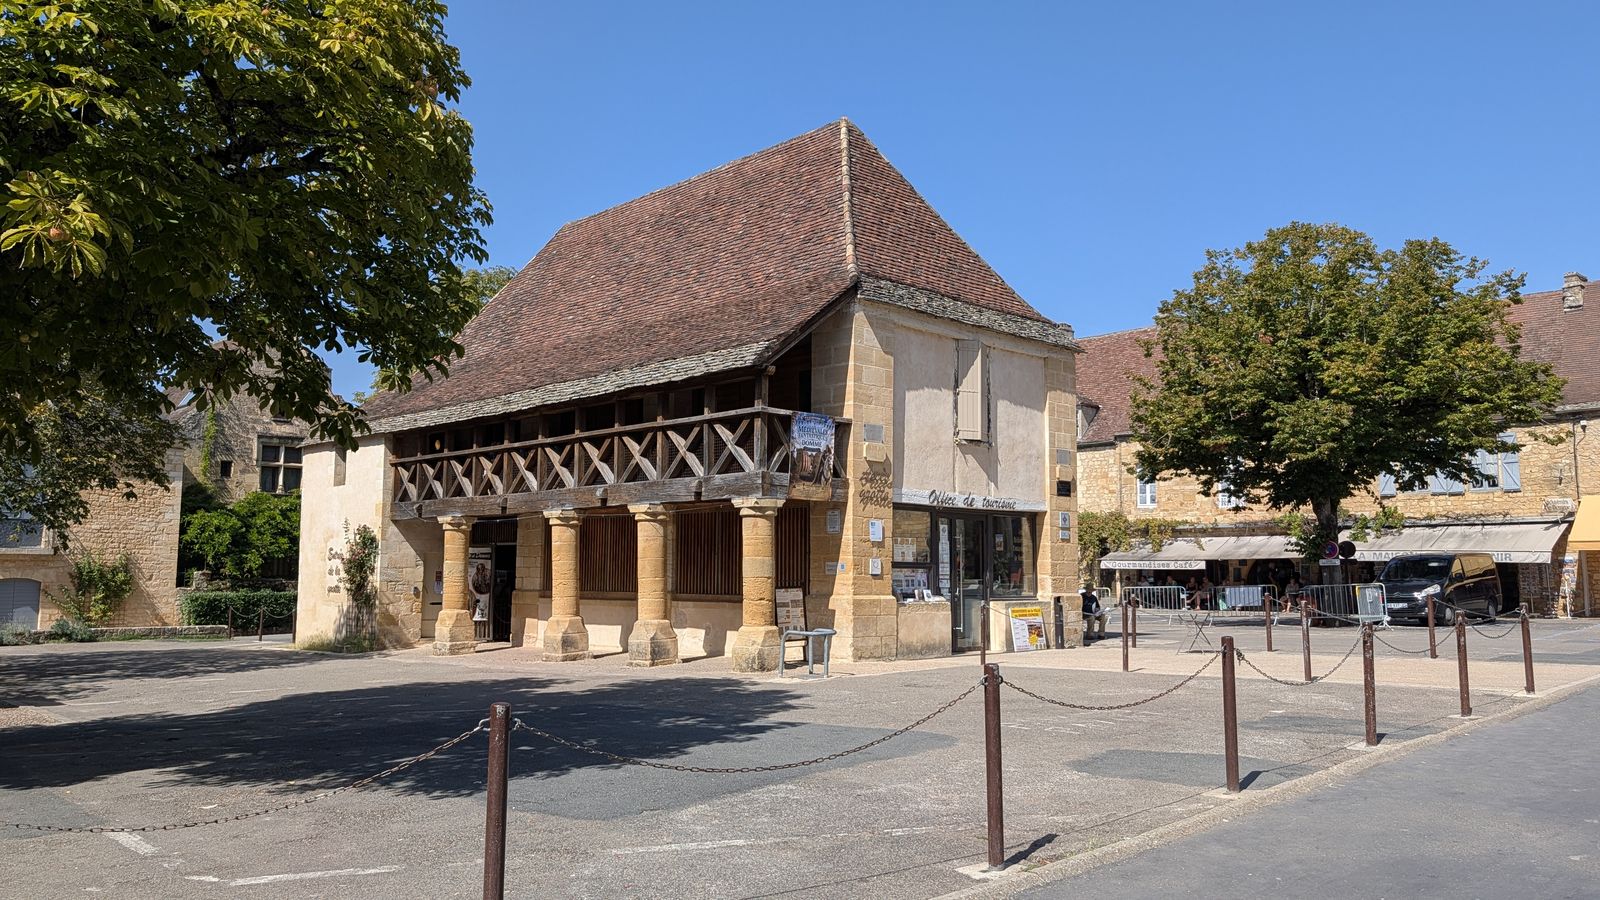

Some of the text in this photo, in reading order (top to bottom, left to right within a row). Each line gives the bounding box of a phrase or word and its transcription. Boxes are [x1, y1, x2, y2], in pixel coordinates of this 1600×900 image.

[928, 489, 1017, 510] Office de tourisme
[1111, 560, 1193, 569] Gourmandises Café
